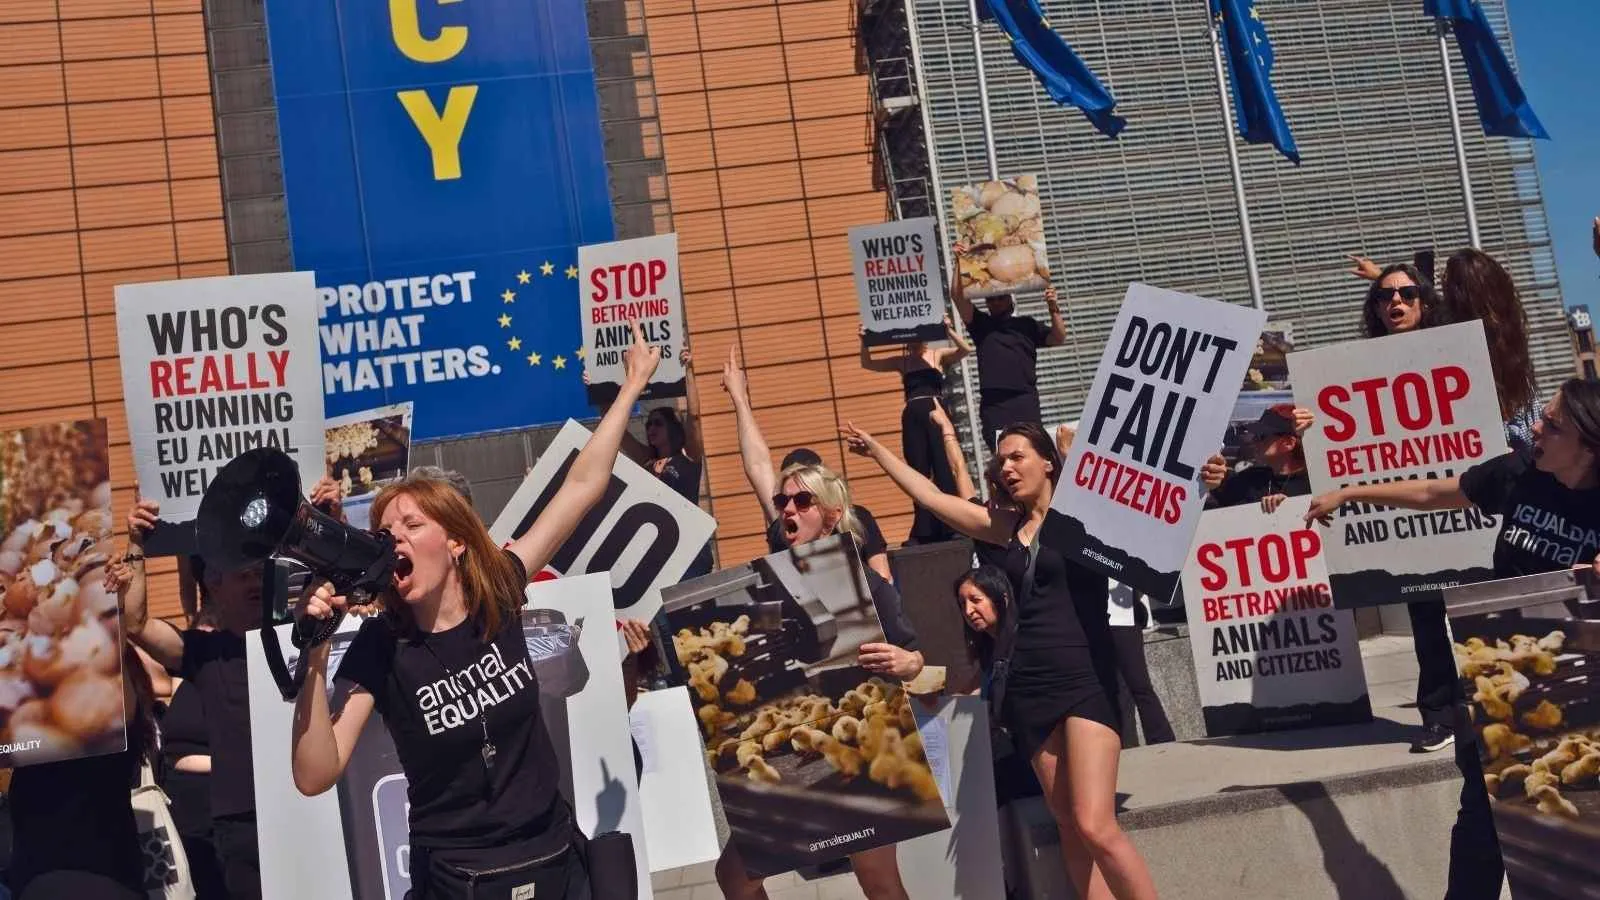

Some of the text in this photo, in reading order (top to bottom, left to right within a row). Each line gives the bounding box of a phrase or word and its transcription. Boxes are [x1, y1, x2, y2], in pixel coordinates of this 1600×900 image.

[862, 233, 923, 259] WHO'S
[864, 254, 925, 278] REALLY
[314, 271, 476, 319] PROTECT
[590, 259, 667, 303] STOP
[868, 273, 928, 293] RUNNING
[869, 289, 931, 307] EU ANIMAL
[146, 303, 288, 356] WHO'S
[592, 298, 669, 325] BETRAYING
[871, 303, 932, 321] WELFARE?
[319, 314, 425, 356] WHAT
[1114, 315, 1237, 394] DON'T
[150, 350, 290, 398] REALLY
[323, 345, 501, 395] MATTERS.
[596, 350, 618, 368] AND
[154, 391, 294, 434] RUNNING
[1317, 365, 1471, 443] STOP
[1087, 373, 1197, 481] FAIL
[157, 437, 188, 466] EU
[1326, 428, 1484, 478] BETRAYING
[1075, 452, 1187, 525] CITIZENS
[1344, 507, 1497, 546] AND CITIZENS
[1503, 525, 1584, 567] animal
[1512, 504, 1600, 549] IGUALDA
[1196, 528, 1321, 592] STOP
[1202, 583, 1332, 622] BETRAYING
[1212, 613, 1338, 656] ANIMALS
[416, 643, 507, 711] animal
[1216, 648, 1342, 682] AND CITIZENS
[424, 658, 533, 735] EQUALITY
